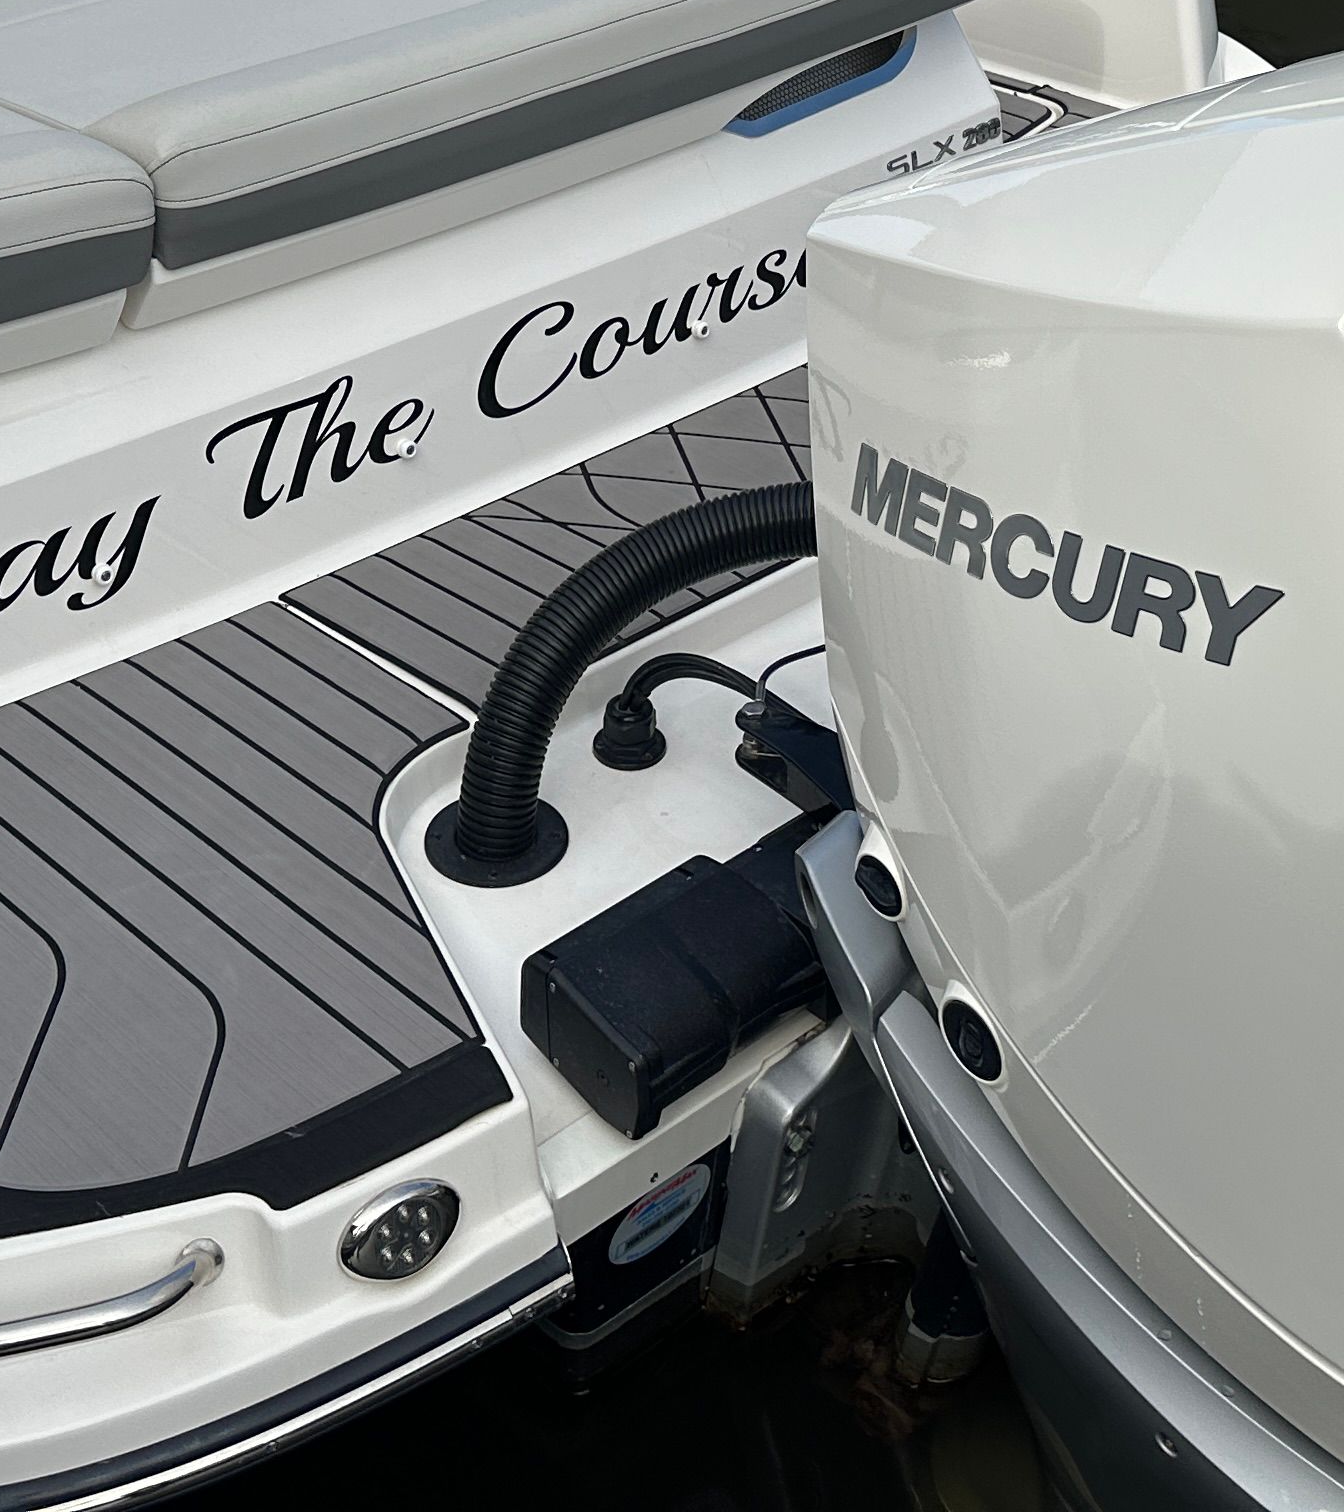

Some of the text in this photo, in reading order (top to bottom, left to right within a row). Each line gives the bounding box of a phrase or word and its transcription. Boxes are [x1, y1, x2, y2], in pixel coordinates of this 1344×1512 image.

[886, 134, 956, 173] SLX
[206, 375, 433, 520] The
[850, 442, 1285, 666] MERCURY
